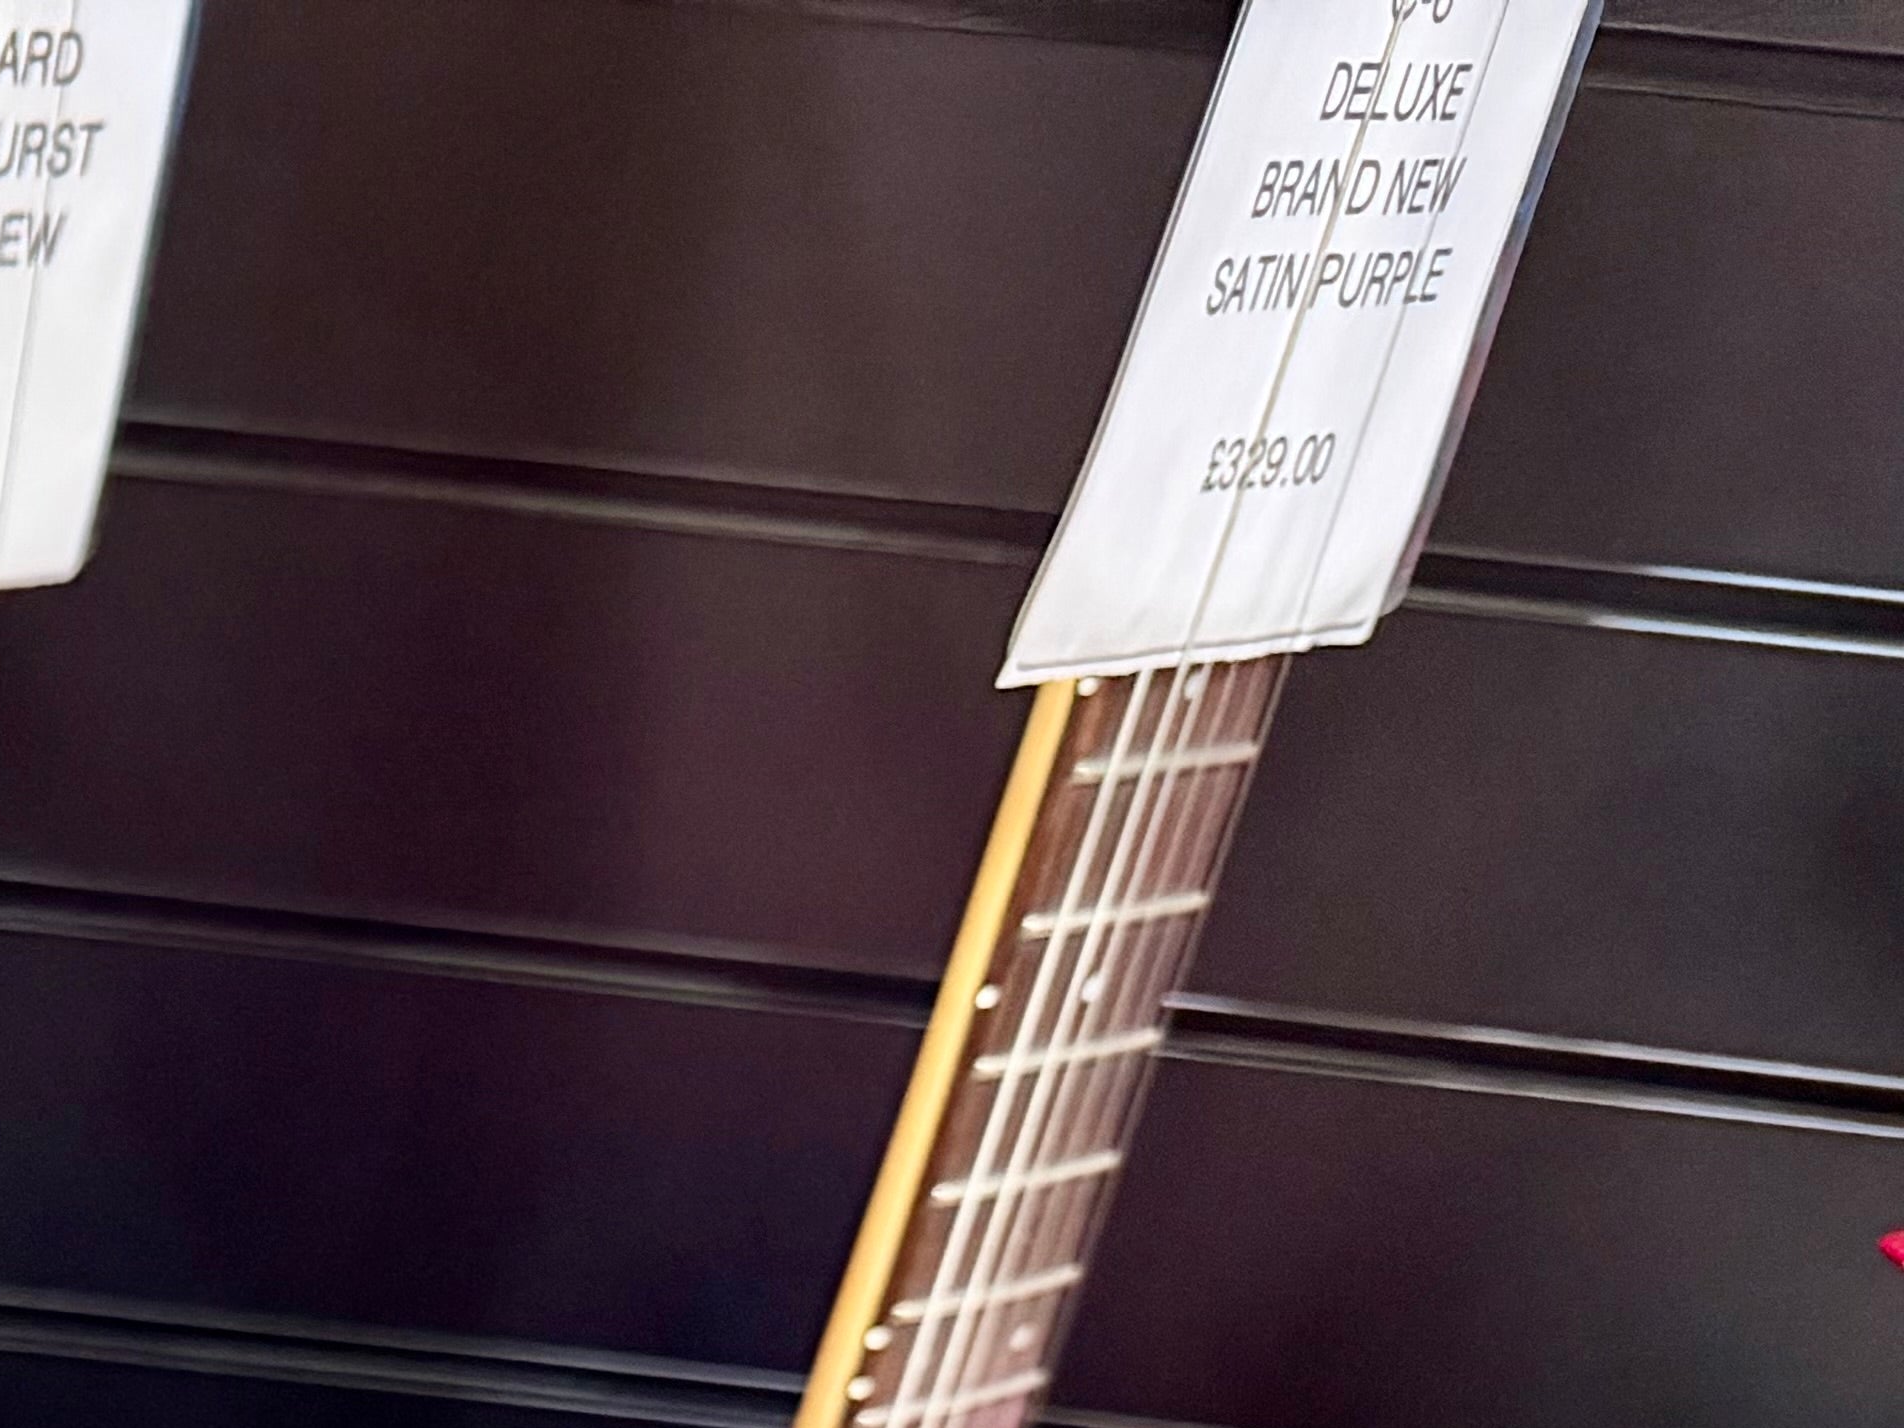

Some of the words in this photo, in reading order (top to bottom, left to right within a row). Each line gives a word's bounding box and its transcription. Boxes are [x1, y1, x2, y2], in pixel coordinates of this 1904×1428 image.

[1319, 61, 1473, 122] DELUXE
[1251, 157, 1381, 219] BRAND
[1381, 156, 1468, 216] NEW
[1205, 252, 1312, 317] SATIN
[1308, 246, 1454, 310] PURPLE
[1199, 431, 1337, 494] £329.00
